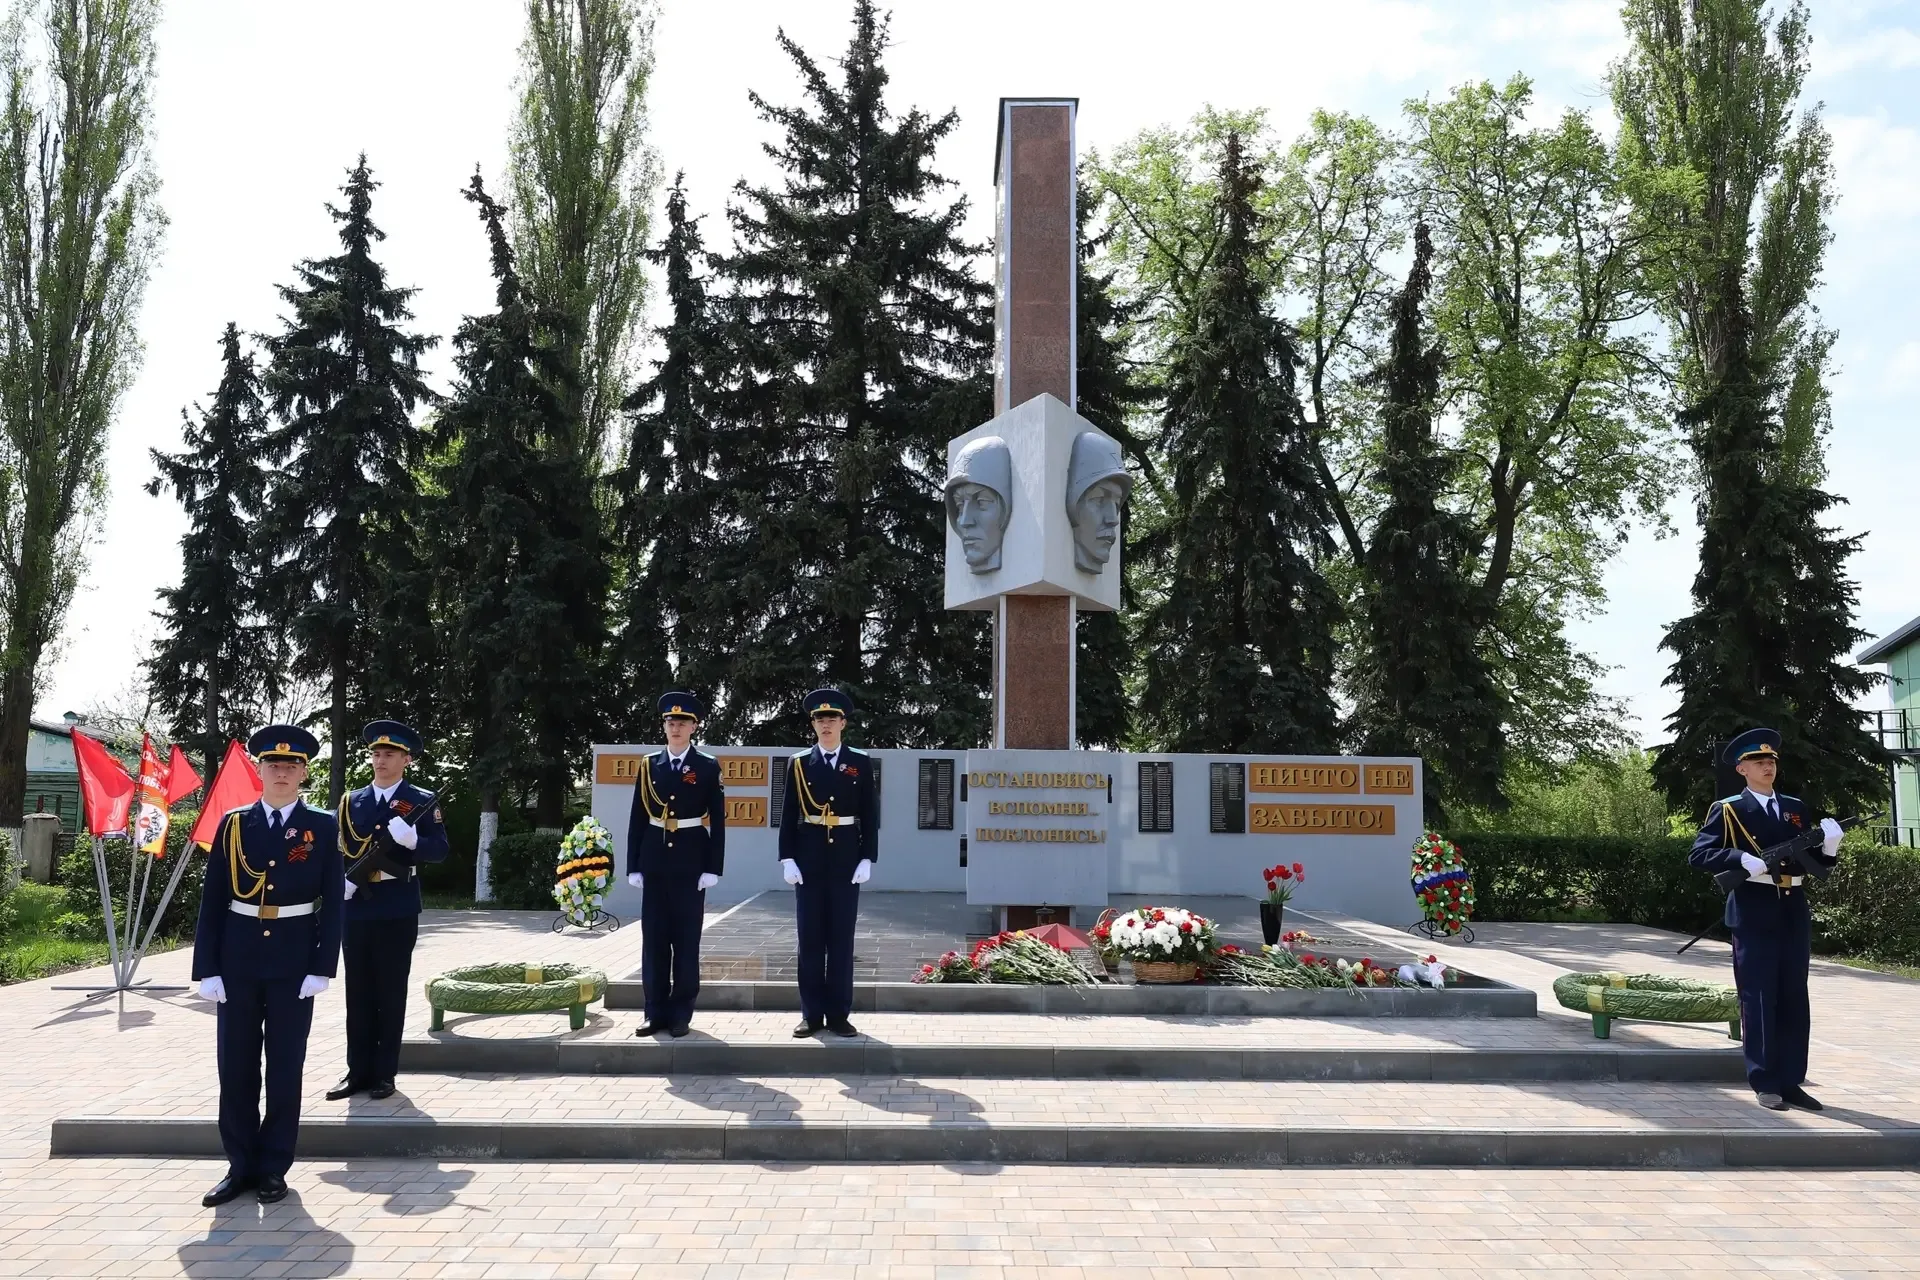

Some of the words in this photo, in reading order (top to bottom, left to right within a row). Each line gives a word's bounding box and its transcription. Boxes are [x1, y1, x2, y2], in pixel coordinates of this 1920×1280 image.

[723, 760, 764, 779] НЕ
[1254, 767, 1357, 788] НИЧТО
[1369, 769, 1410, 789] НЕ
[968, 771, 1108, 789] ОСТАНОВИСЬ
[1253, 807, 1384, 829] ЗАБЫТО!
[976, 827, 1106, 844] ПОКЛОНИСЬ!
